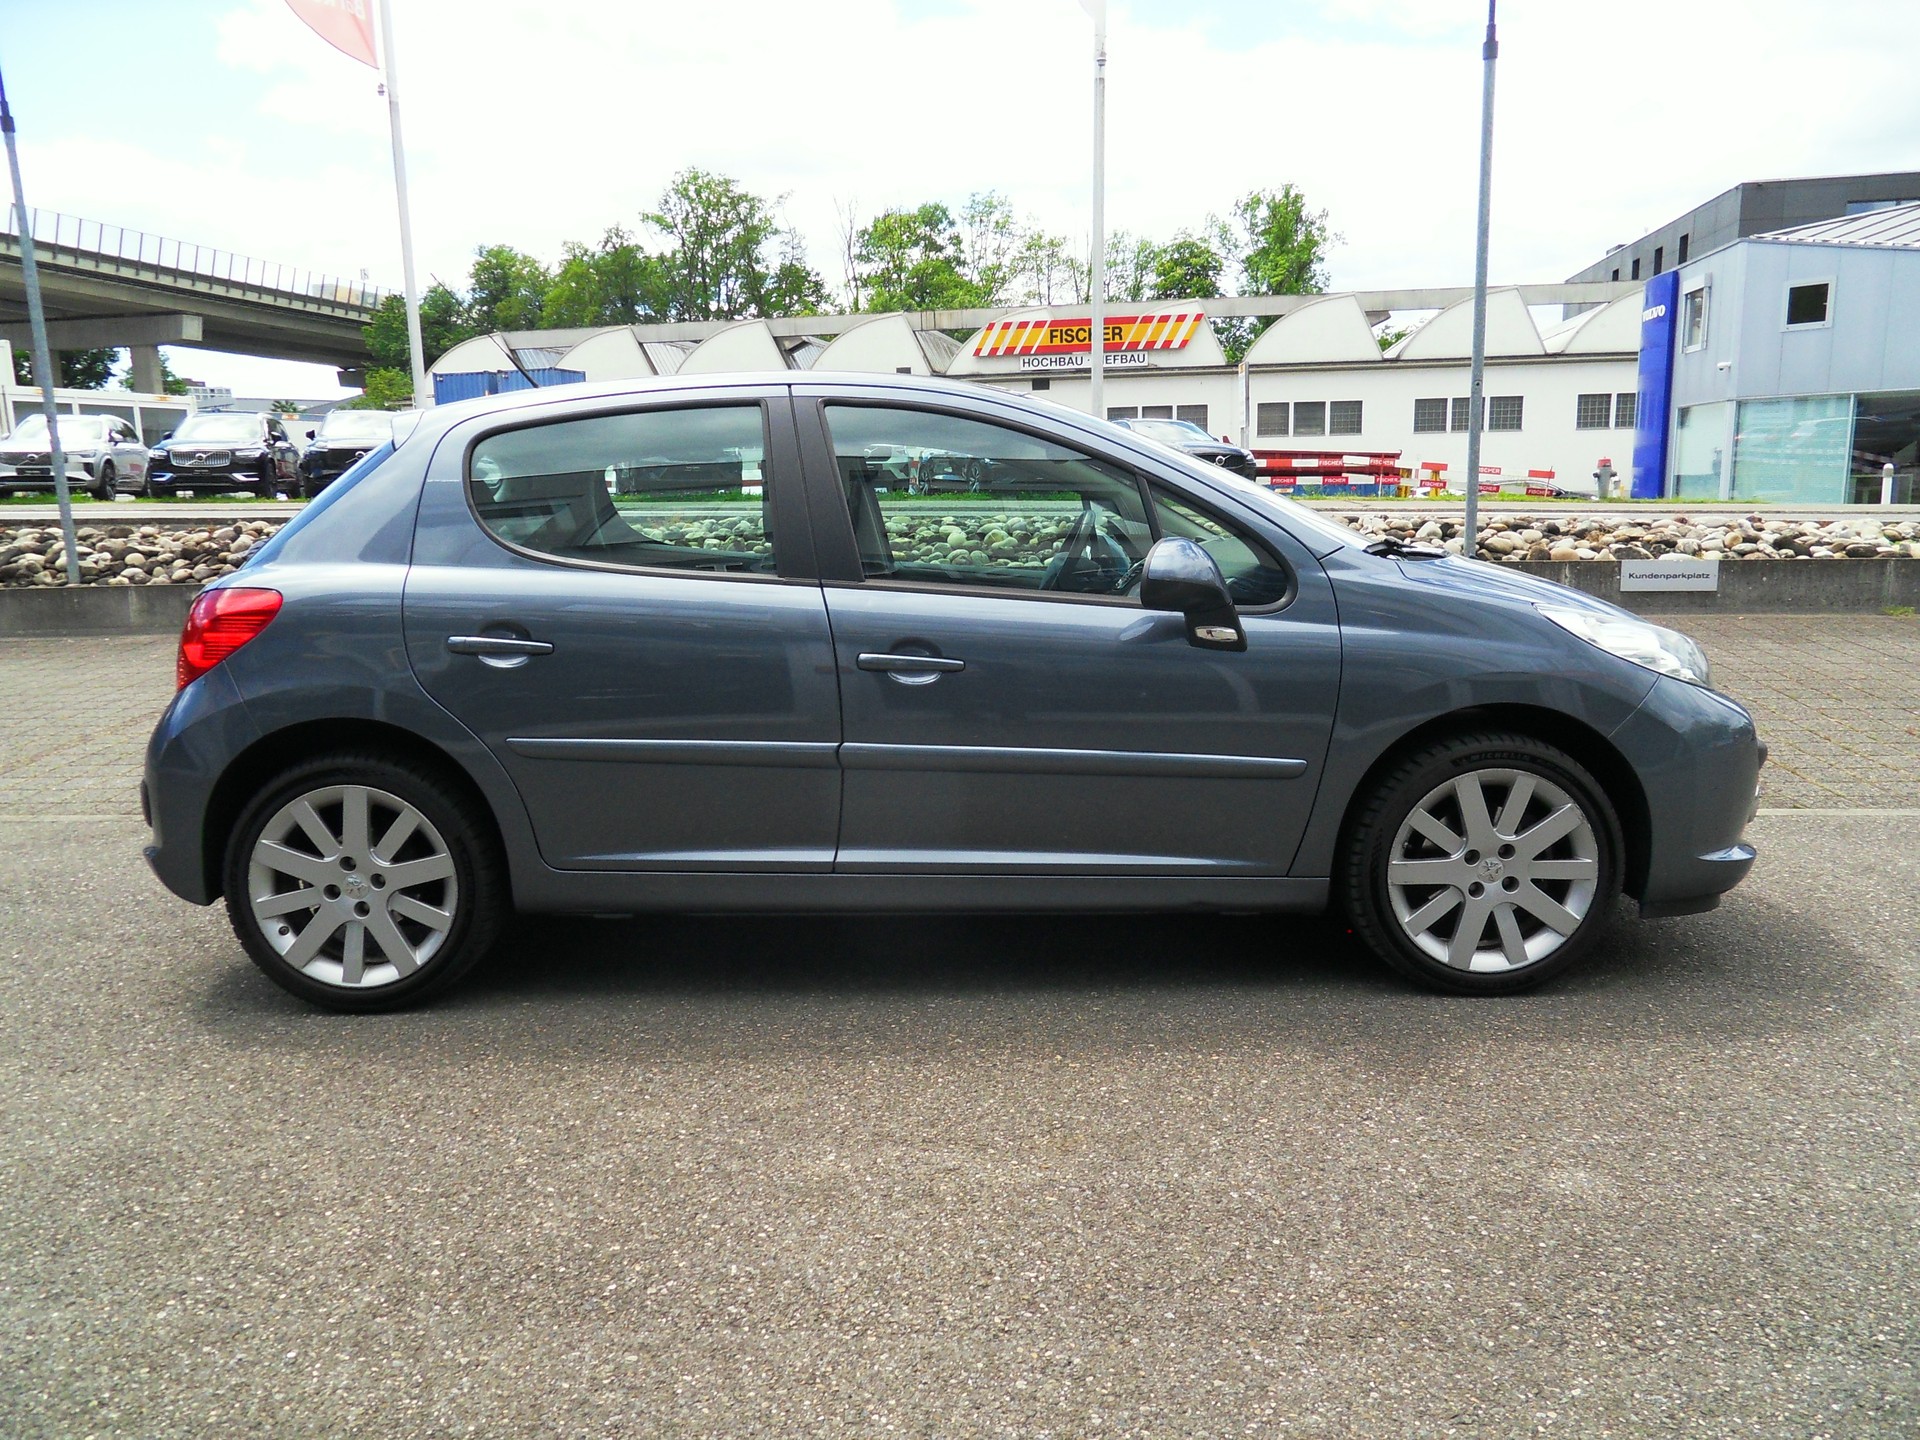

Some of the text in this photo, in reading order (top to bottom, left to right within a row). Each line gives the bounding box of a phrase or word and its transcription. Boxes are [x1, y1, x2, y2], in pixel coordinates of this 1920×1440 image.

[1049, 326, 1123, 344] FISCER
[1022, 353, 1146, 368] HOCHBAU EFBAU
[1628, 572, 1711, 580] Kundenparkplatz
